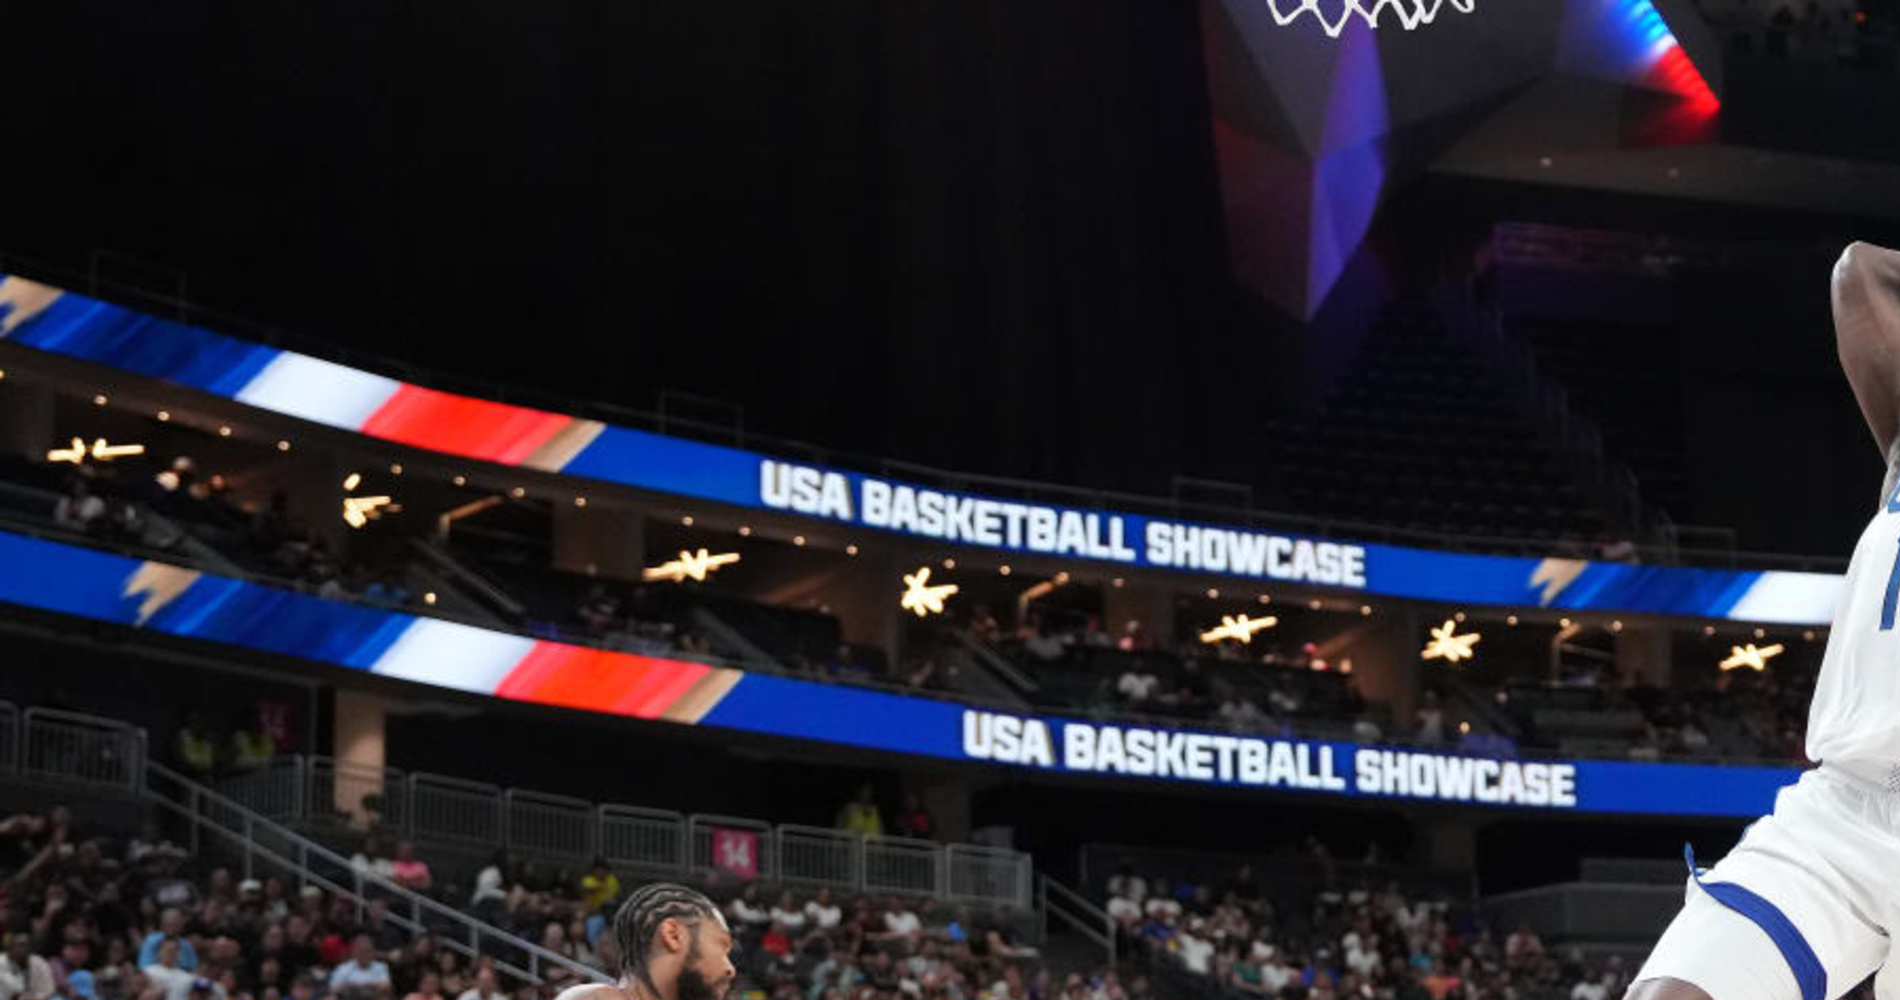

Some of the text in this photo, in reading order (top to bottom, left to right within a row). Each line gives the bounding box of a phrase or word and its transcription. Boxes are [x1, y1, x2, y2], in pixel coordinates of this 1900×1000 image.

[760, 460, 1366, 588] USA BASKETBALL SHOWCASE
[963, 710, 1576, 807] USA BASKETBALL SHOWCASE
[722, 838, 751, 869] 14
